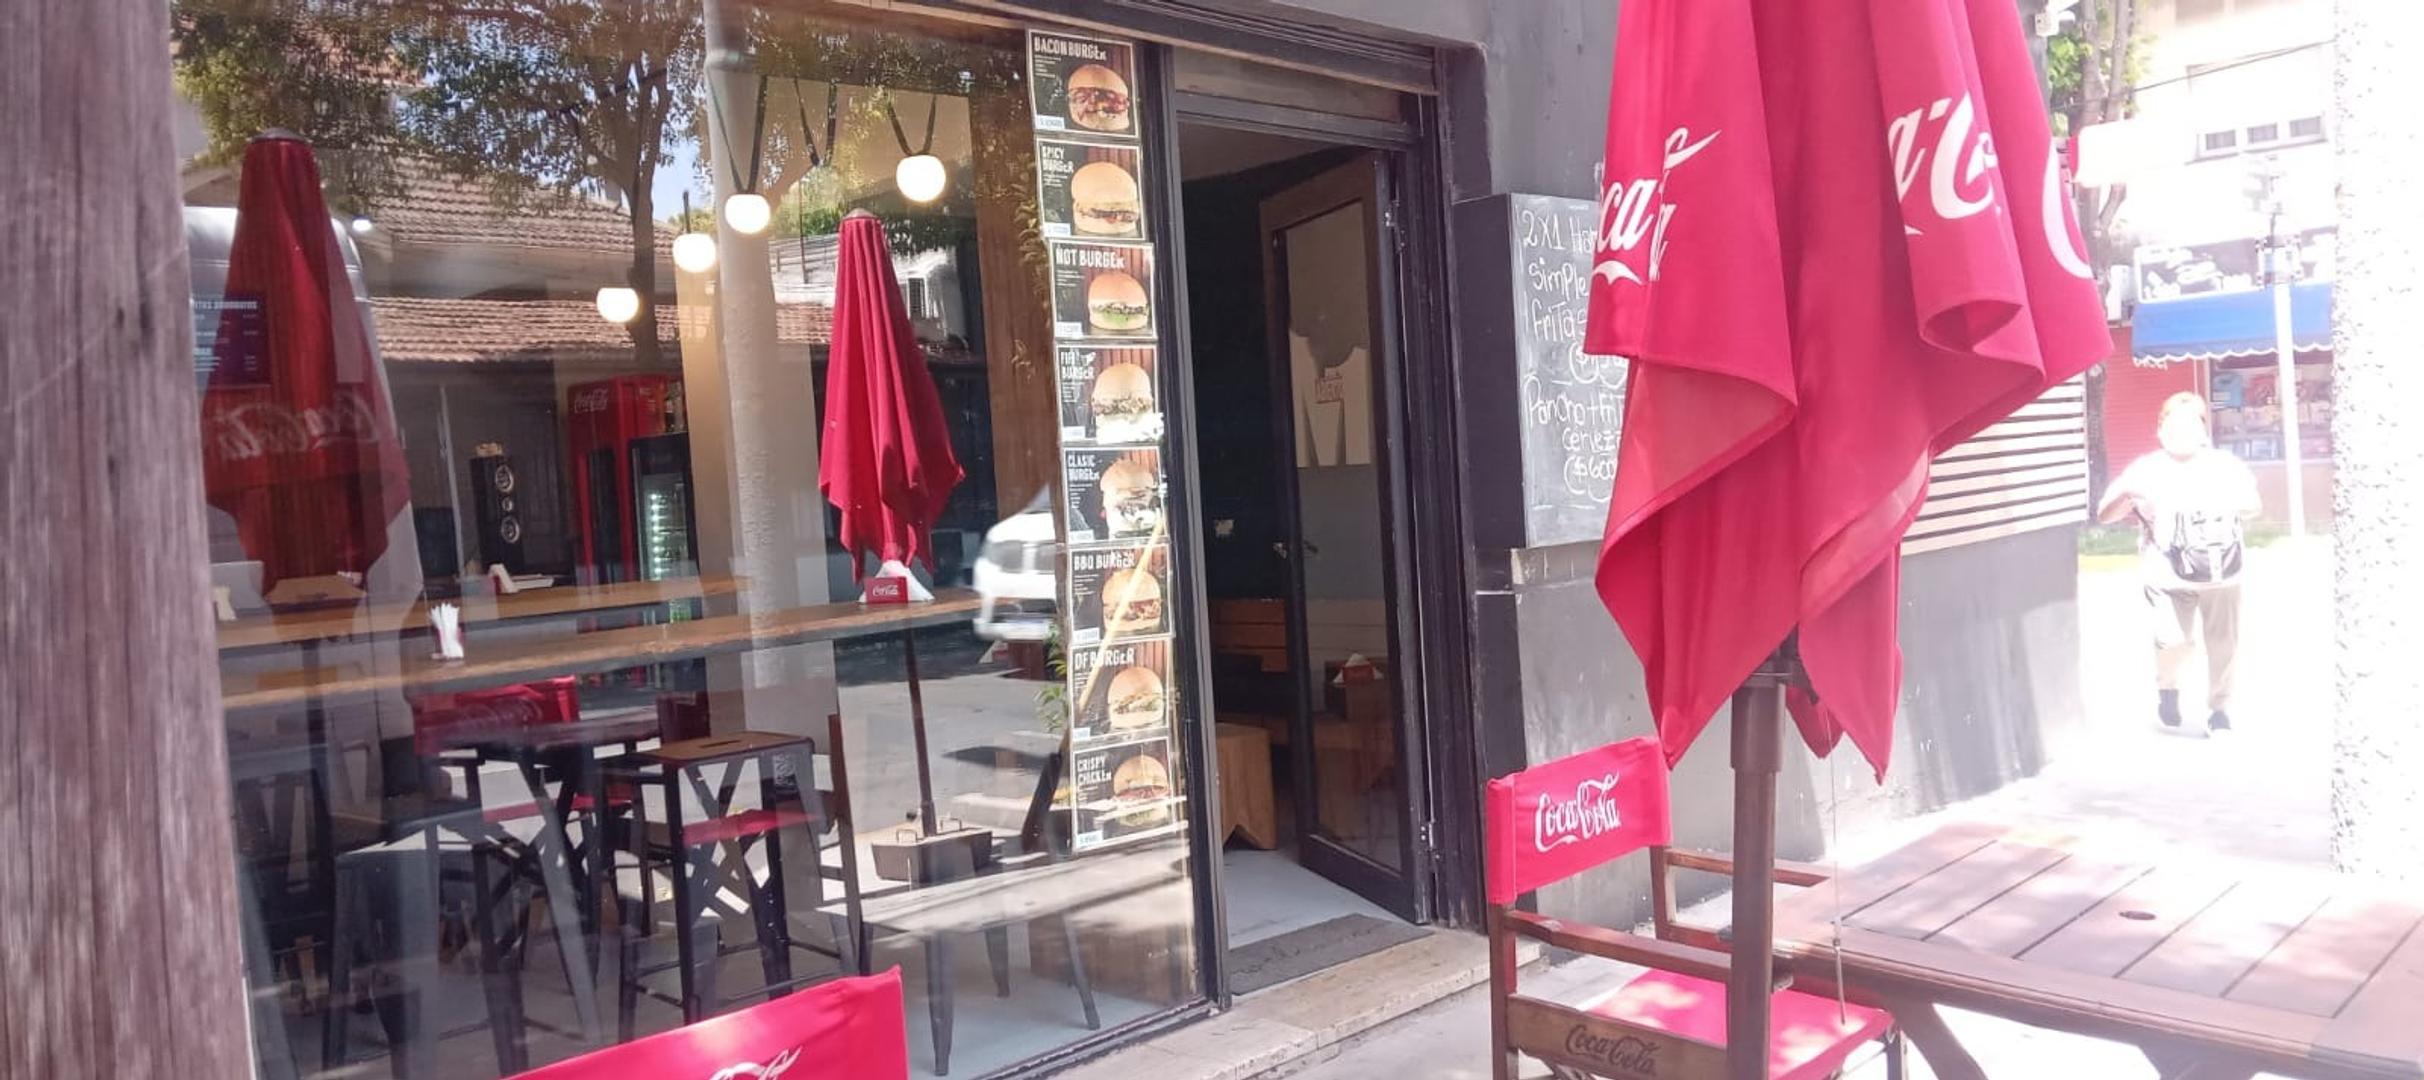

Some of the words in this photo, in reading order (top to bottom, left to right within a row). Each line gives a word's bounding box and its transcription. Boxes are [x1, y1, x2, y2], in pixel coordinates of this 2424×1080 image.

[1034, 36, 1067, 55] BACON
[1068, 41, 1107, 61] BURGER
[1079, 250, 1125, 268] BURGER
[1074, 553, 1094, 571] BBQ
[1077, 756, 1105, 772] CRISPY
[1078, 771, 1112, 785] CHICKEN
